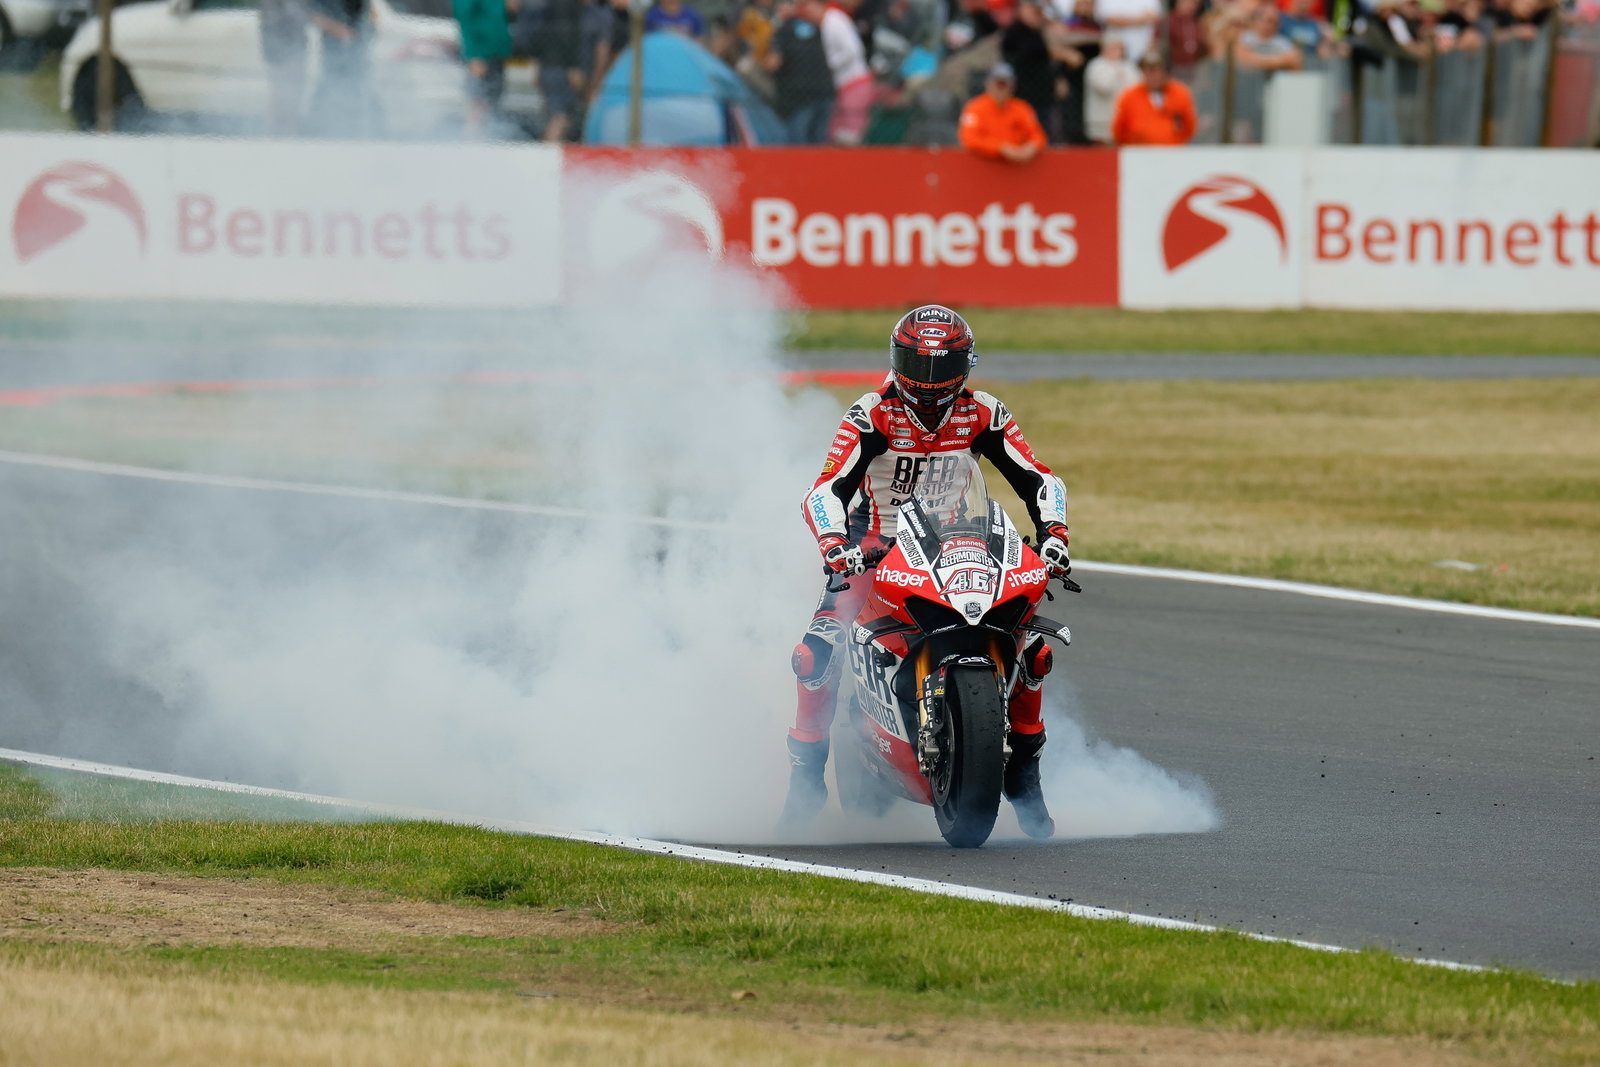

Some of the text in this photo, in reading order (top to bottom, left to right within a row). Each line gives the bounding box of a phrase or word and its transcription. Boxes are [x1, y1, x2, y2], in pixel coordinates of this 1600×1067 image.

[177, 193, 511, 259] Bennetts
[751, 199, 1077, 268] Bennetts
[920, 309, 949, 319] MINT
[956, 540, 987, 550] Bennetts
[940, 551, 995, 568] BEERMONSTER
[943, 568, 992, 594] 46
[925, 674, 933, 729] PIRELLI
